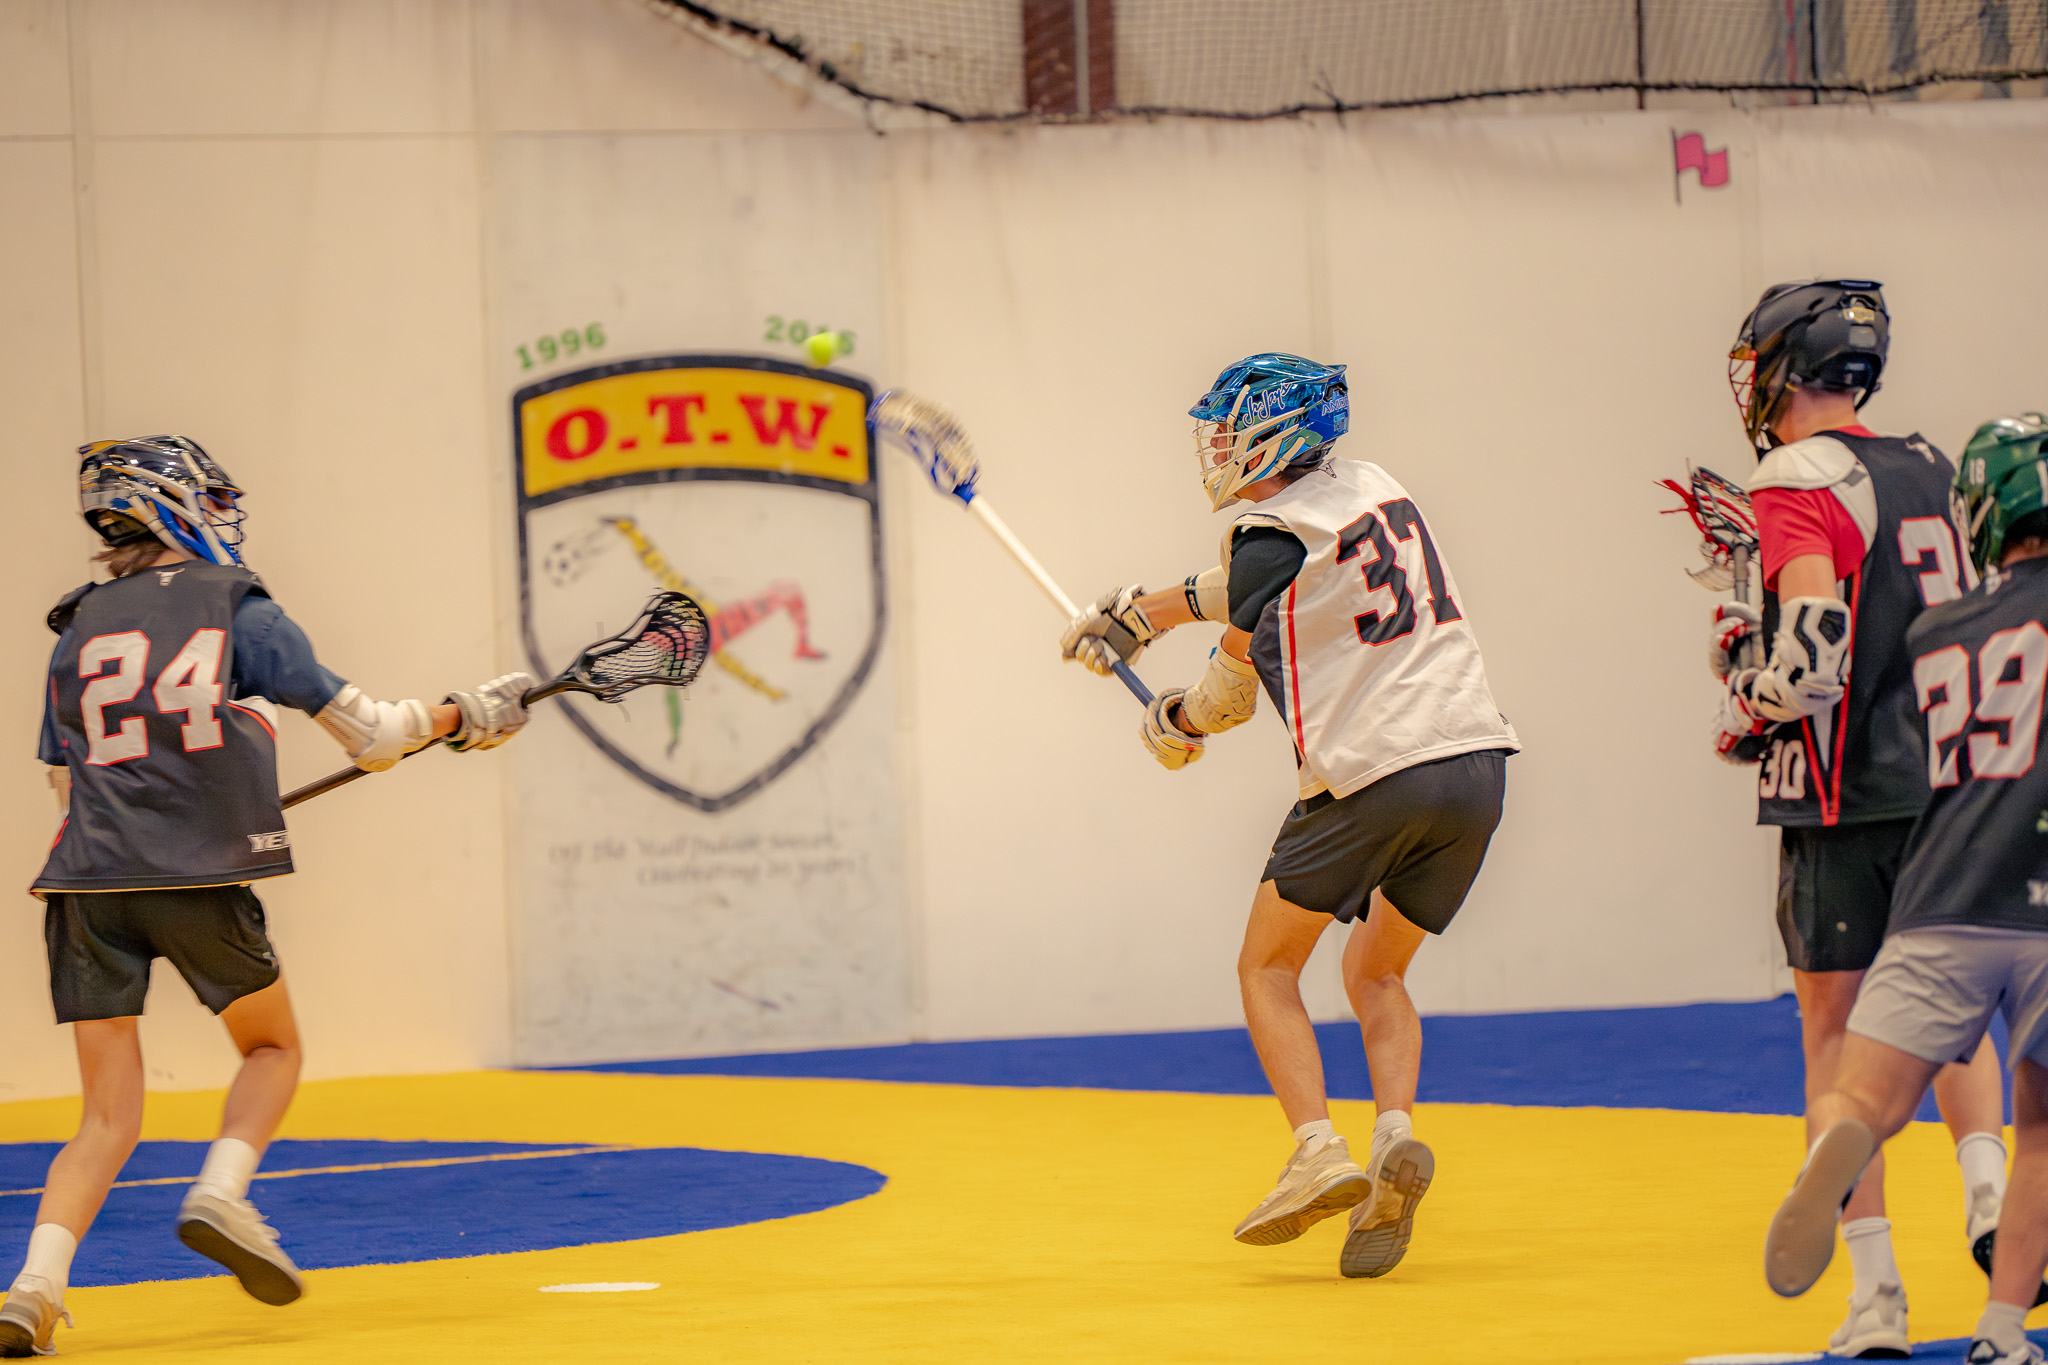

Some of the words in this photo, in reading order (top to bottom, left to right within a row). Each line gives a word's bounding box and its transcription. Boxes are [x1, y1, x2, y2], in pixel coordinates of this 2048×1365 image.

[514, 322, 607, 370] 1996
[545, 393, 852, 462] O.T.W.
[1336, 497, 1462, 647] 37
[1898, 515, 1980, 607] 3
[79, 628, 226, 766] 24
[1914, 620, 2048, 790] 29
[247, 830, 291, 853] YE
